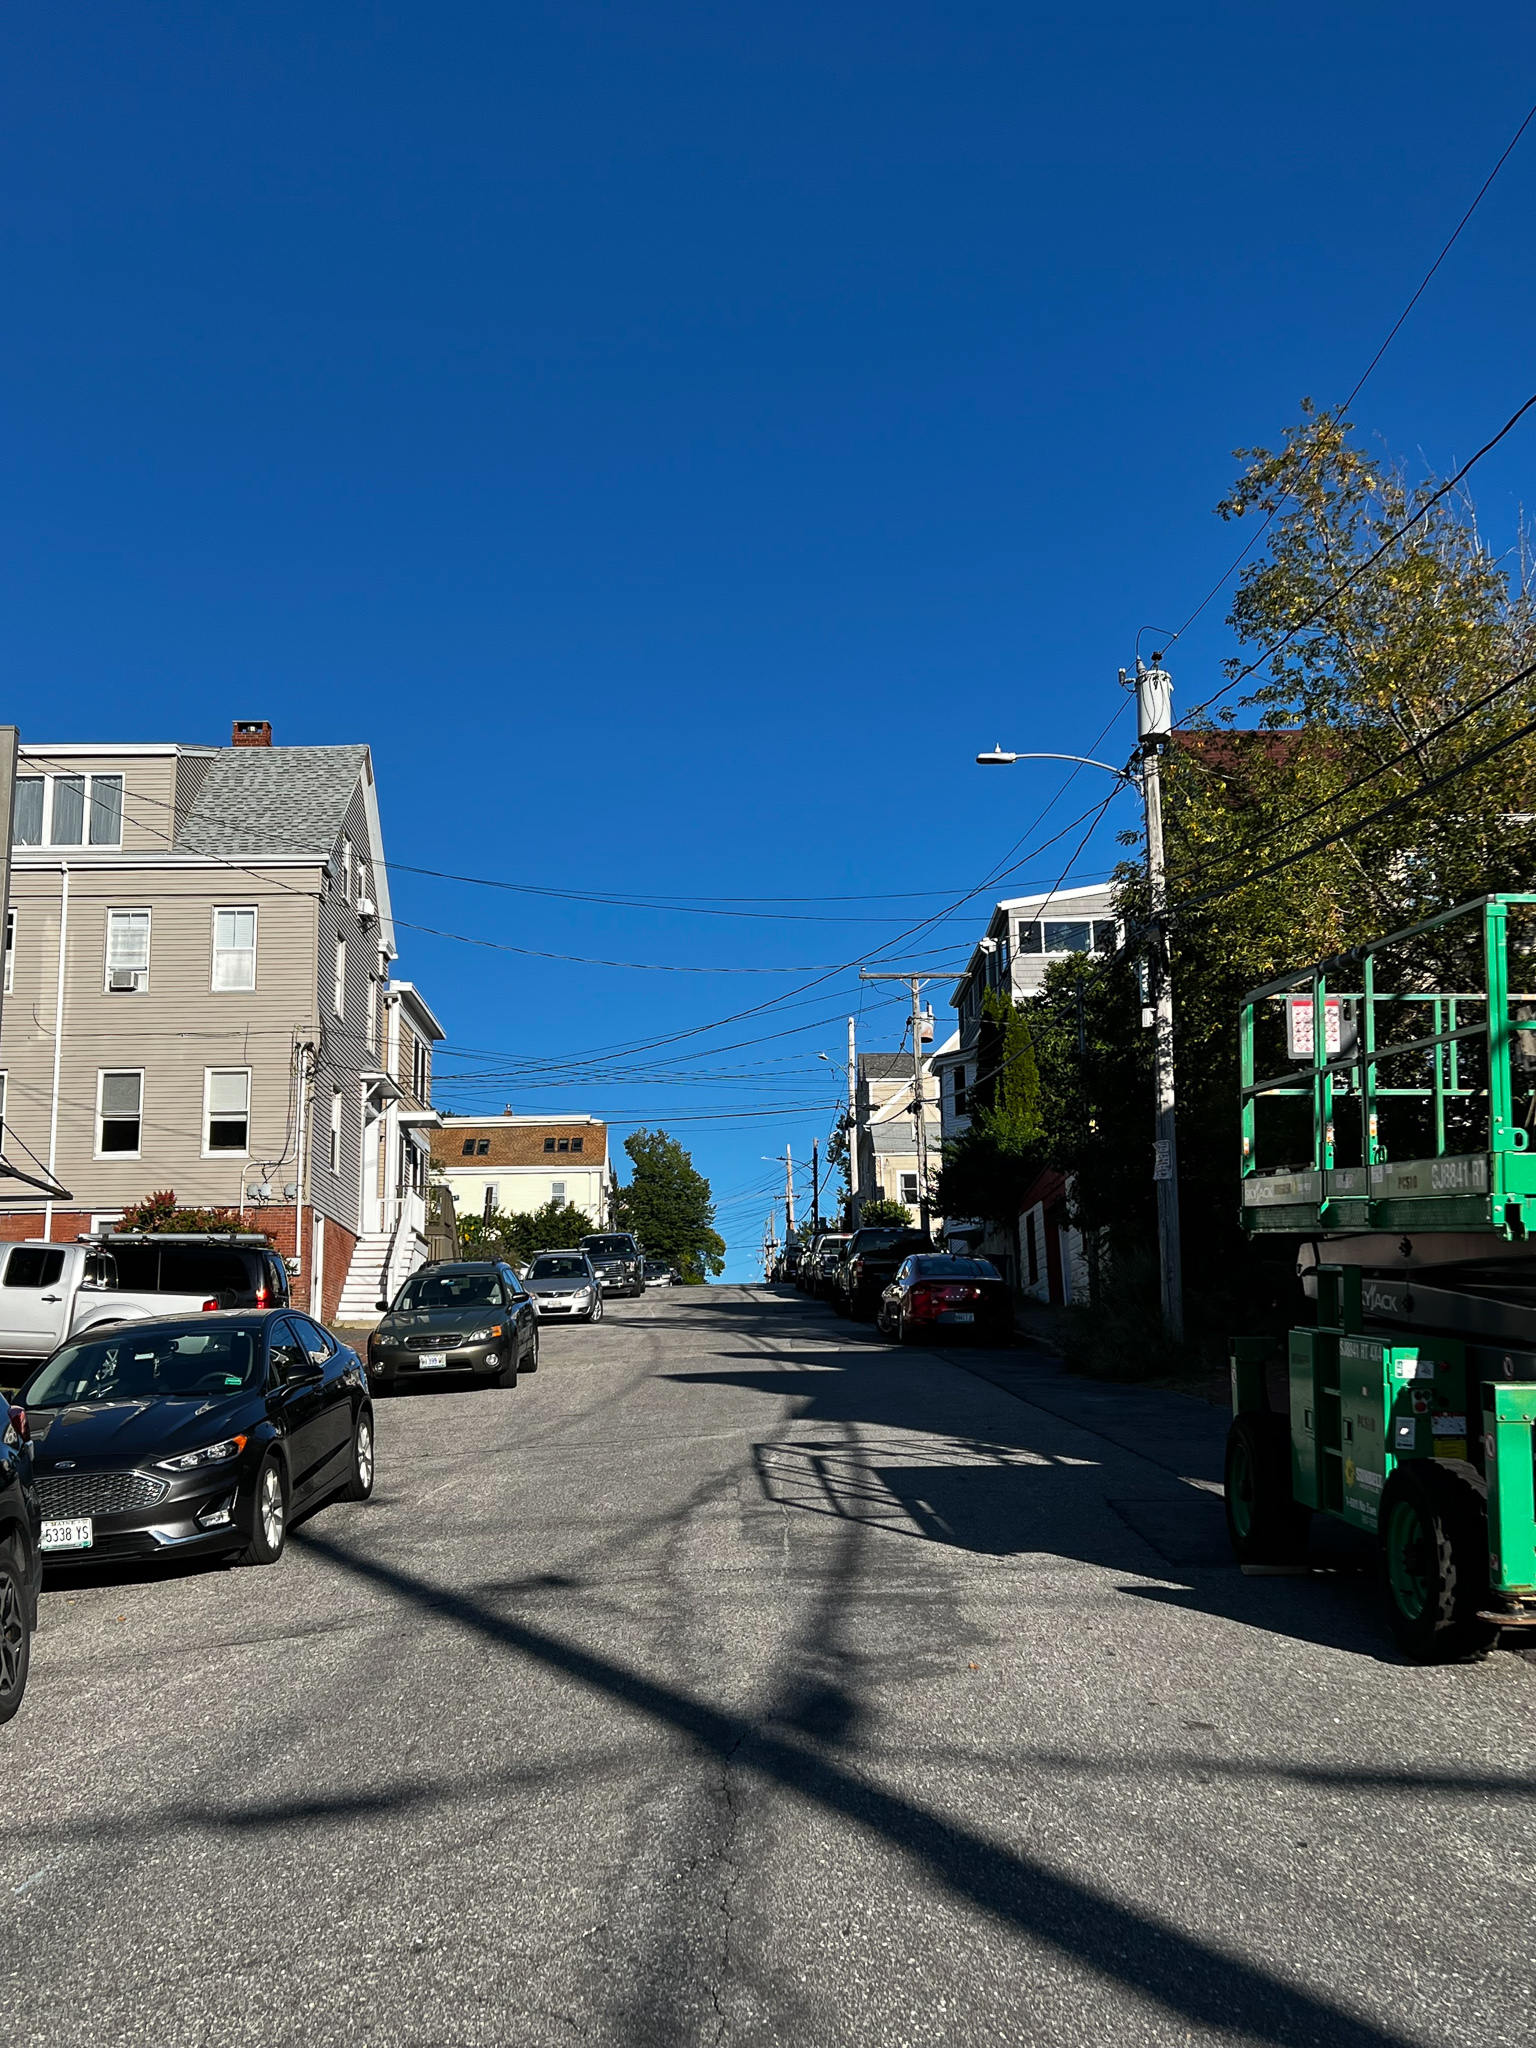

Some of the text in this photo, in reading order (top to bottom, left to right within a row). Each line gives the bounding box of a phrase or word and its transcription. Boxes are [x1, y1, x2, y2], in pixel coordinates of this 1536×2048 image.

[1472, 1160, 1485, 1186] RT
[1355, 1467, 1383, 1489] SUNBELT
[45, 1525, 89, 1543] 5338 YS
